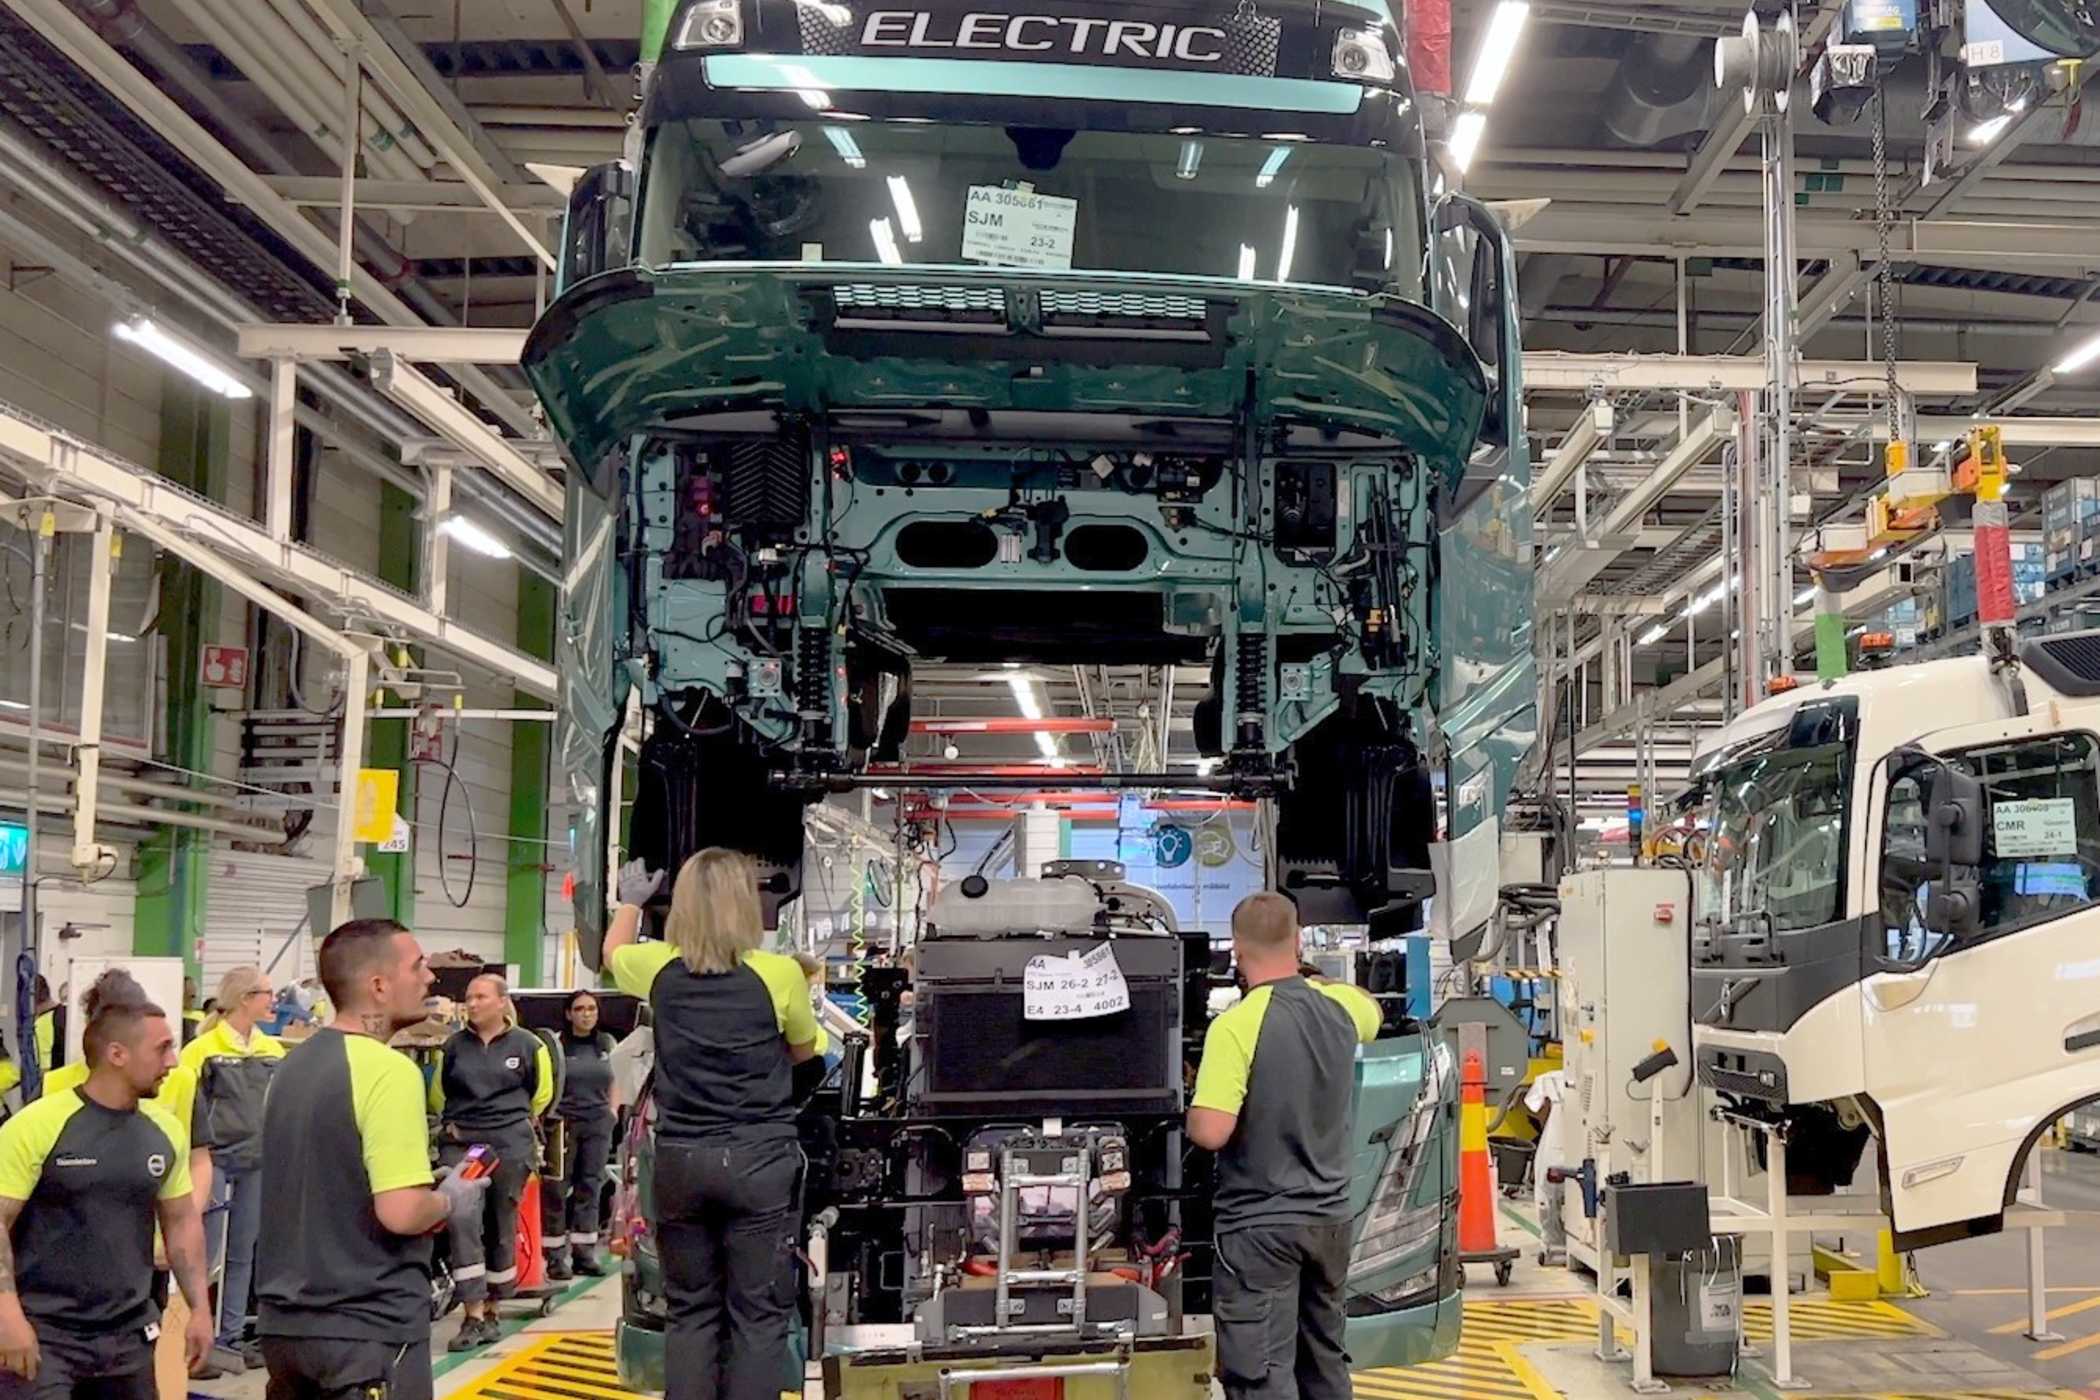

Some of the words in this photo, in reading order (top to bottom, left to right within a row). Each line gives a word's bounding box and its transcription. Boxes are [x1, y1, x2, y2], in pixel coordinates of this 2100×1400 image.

[861, 11, 1225, 61] ELECTRIC
[970, 190, 991, 203] AA
[968, 210, 1003, 227] SJM
[1030, 236, 1055, 249] 23-2
[1996, 805, 2012, 815] AA
[1996, 820, 2025, 832] CMR
[1028, 959, 1046, 969] AA
[1026, 980, 1055, 991] SJM
[1061, 978, 1089, 990] 26-2
[1054, 1004, 1082, 1015] 23-4
[1094, 995, 1124, 1011] 4002
